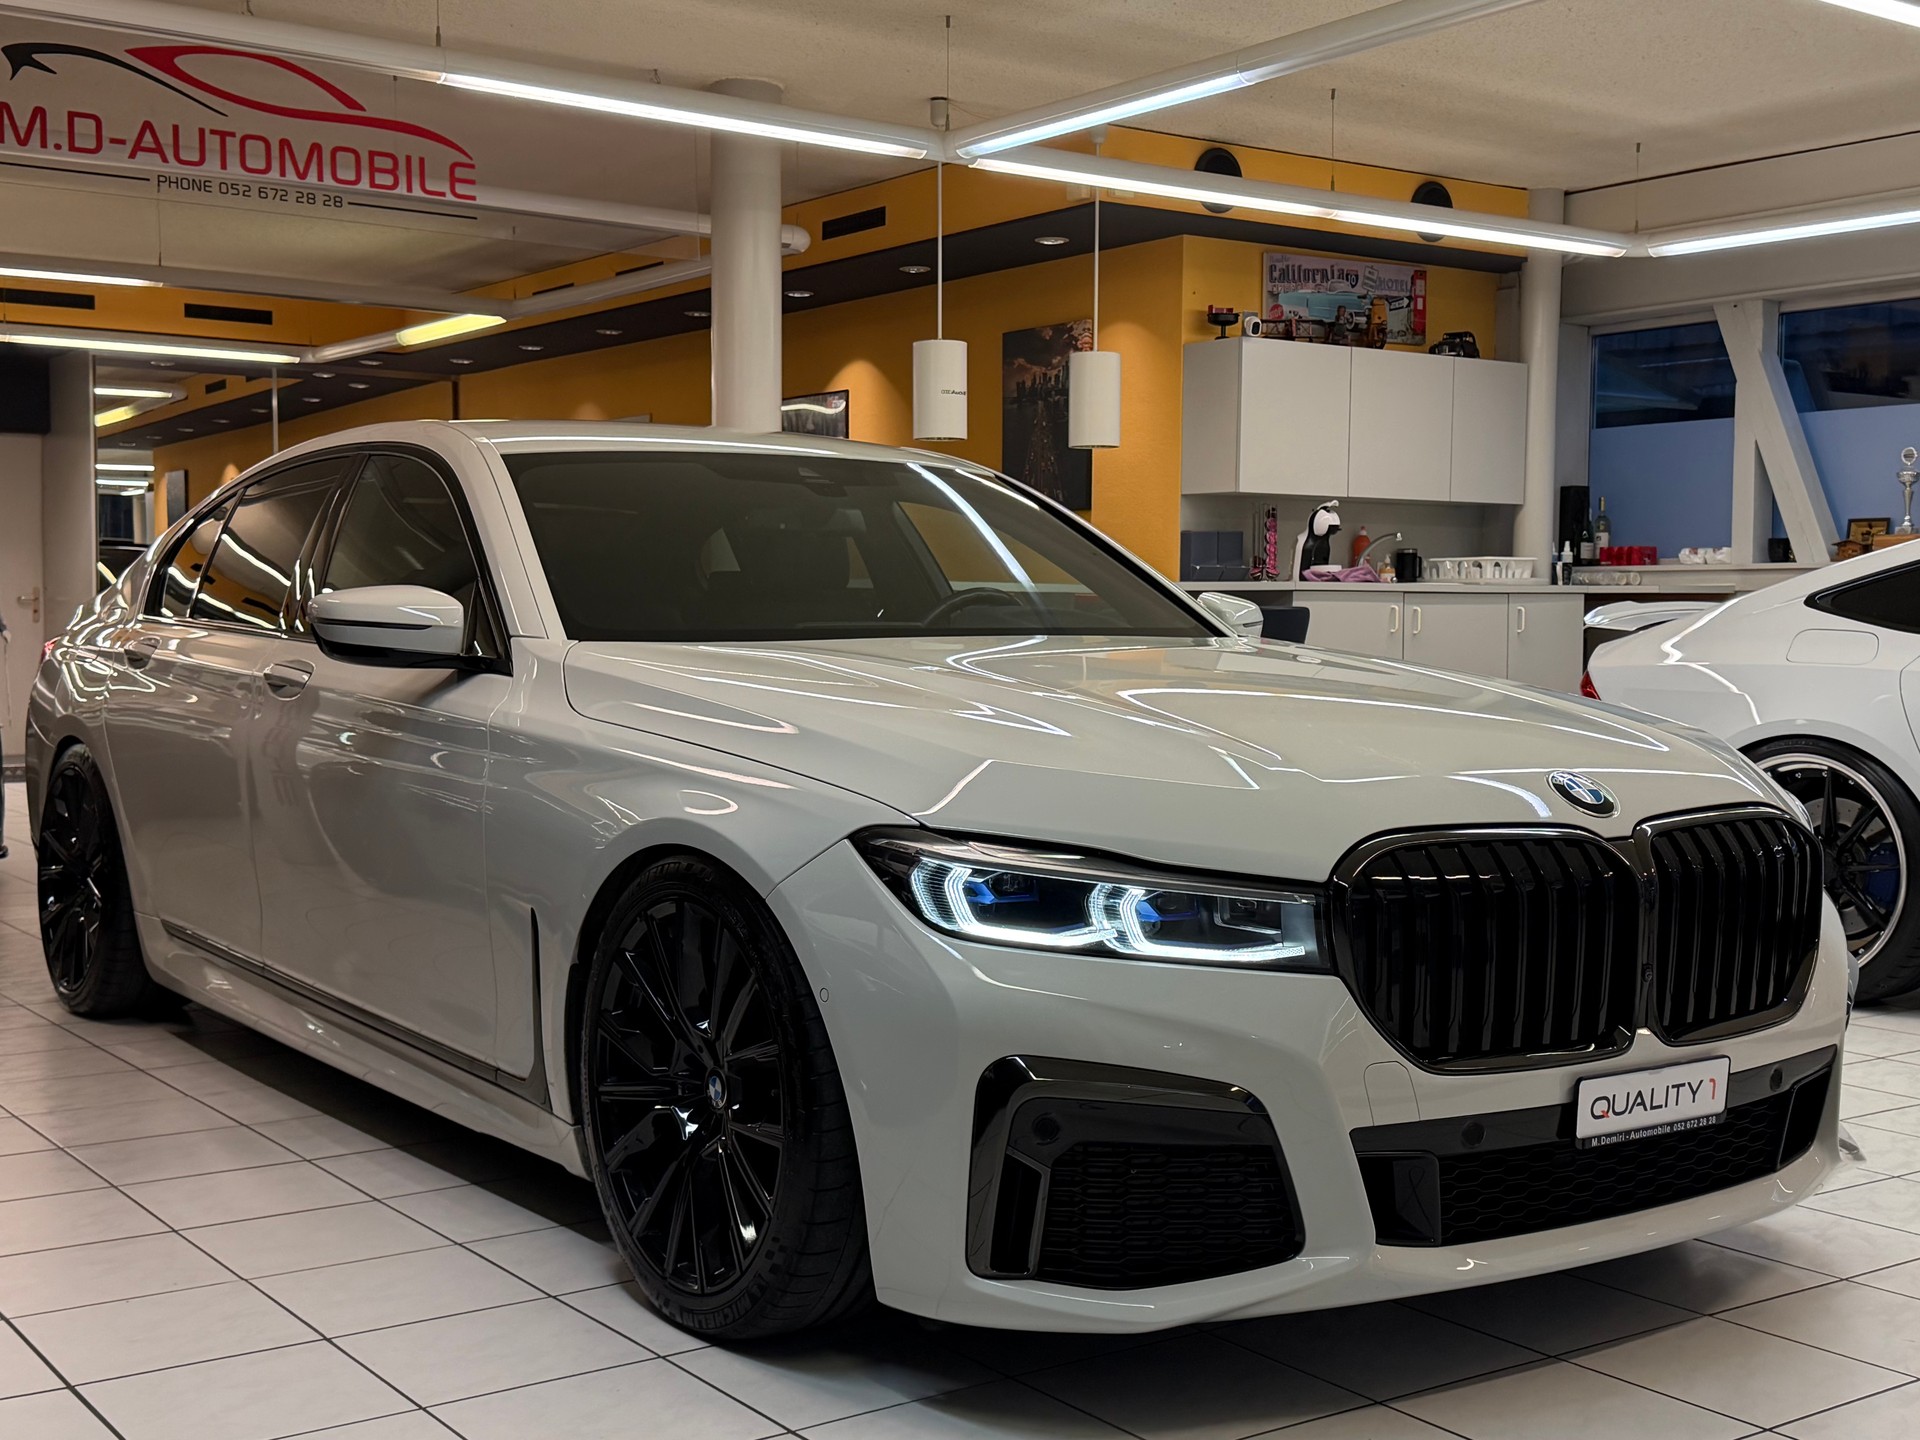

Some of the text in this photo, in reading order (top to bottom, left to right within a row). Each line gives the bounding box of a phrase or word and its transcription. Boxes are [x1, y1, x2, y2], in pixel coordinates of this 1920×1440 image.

[0, 101, 477, 201] M.D-AUTOMOBILE
[157, 174, 344, 208] PHONE 052 672 28 28
[1268, 263, 1346, 284] California
[1590, 1078, 1717, 1120] QUALITY 1
[1630, 1125, 1671, 1140] Automobile
[1673, 1122, 1685, 1132] 052
[1686, 1119, 1698, 1129] 672
[1699, 1117, 1707, 1126] 28
[1709, 1115, 1717, 1125] 28
